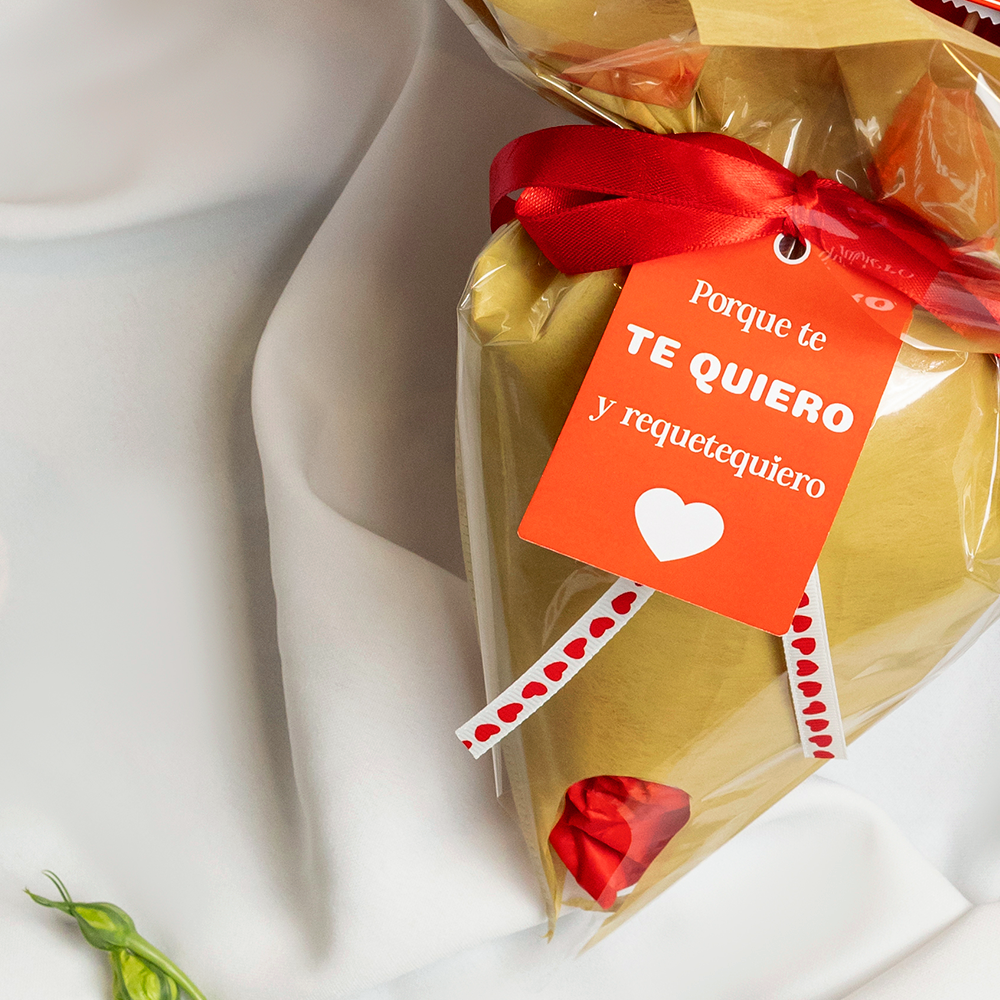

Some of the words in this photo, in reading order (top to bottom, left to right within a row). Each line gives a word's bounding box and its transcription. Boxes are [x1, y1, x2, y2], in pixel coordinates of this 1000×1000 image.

[688, 279, 793, 338] Porque
[797, 321, 827, 352] te
[626, 323, 682, 369] TE
[689, 351, 854, 434] QUIERO
[588, 395, 617, 422] y
[619, 405, 826, 500] requetequiero
